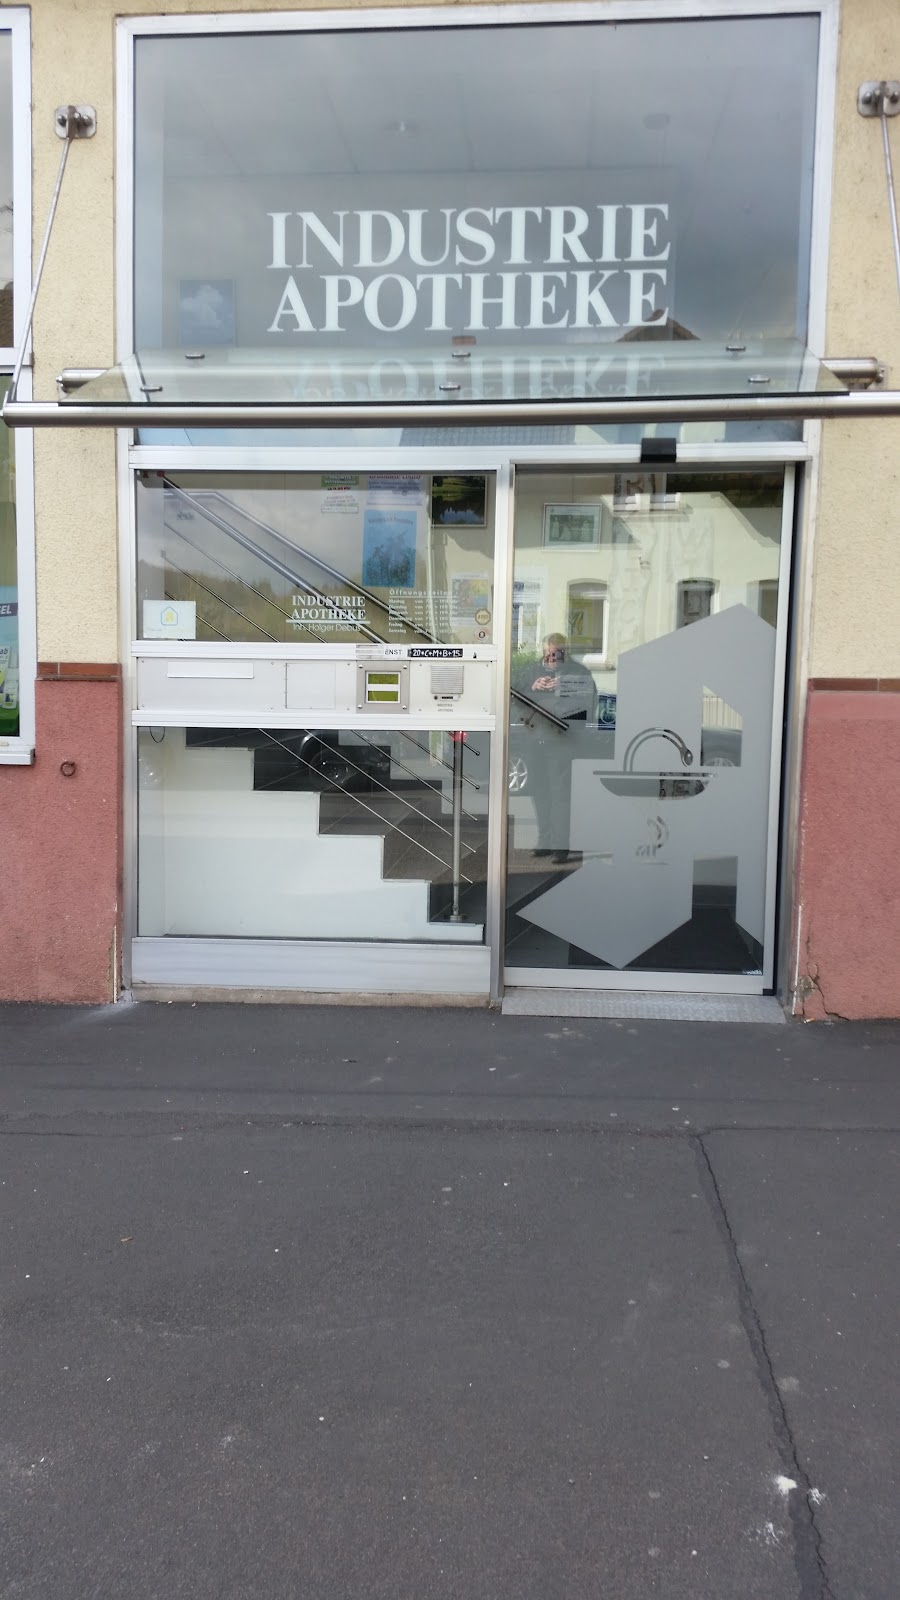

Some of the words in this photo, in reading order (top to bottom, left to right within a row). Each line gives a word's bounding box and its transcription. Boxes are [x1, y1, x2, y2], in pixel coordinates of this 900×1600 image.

[267, 204, 671, 269] INDUSTRIE
[267, 268, 669, 332] APOTHEKE
[292, 595, 366, 607] INDUSTRIE
[0, 605, 12, 615] EL
[291, 608, 366, 620] APOTHEKE
[308, 623, 334, 633] Holger
[335, 624, 361, 632] Debus
